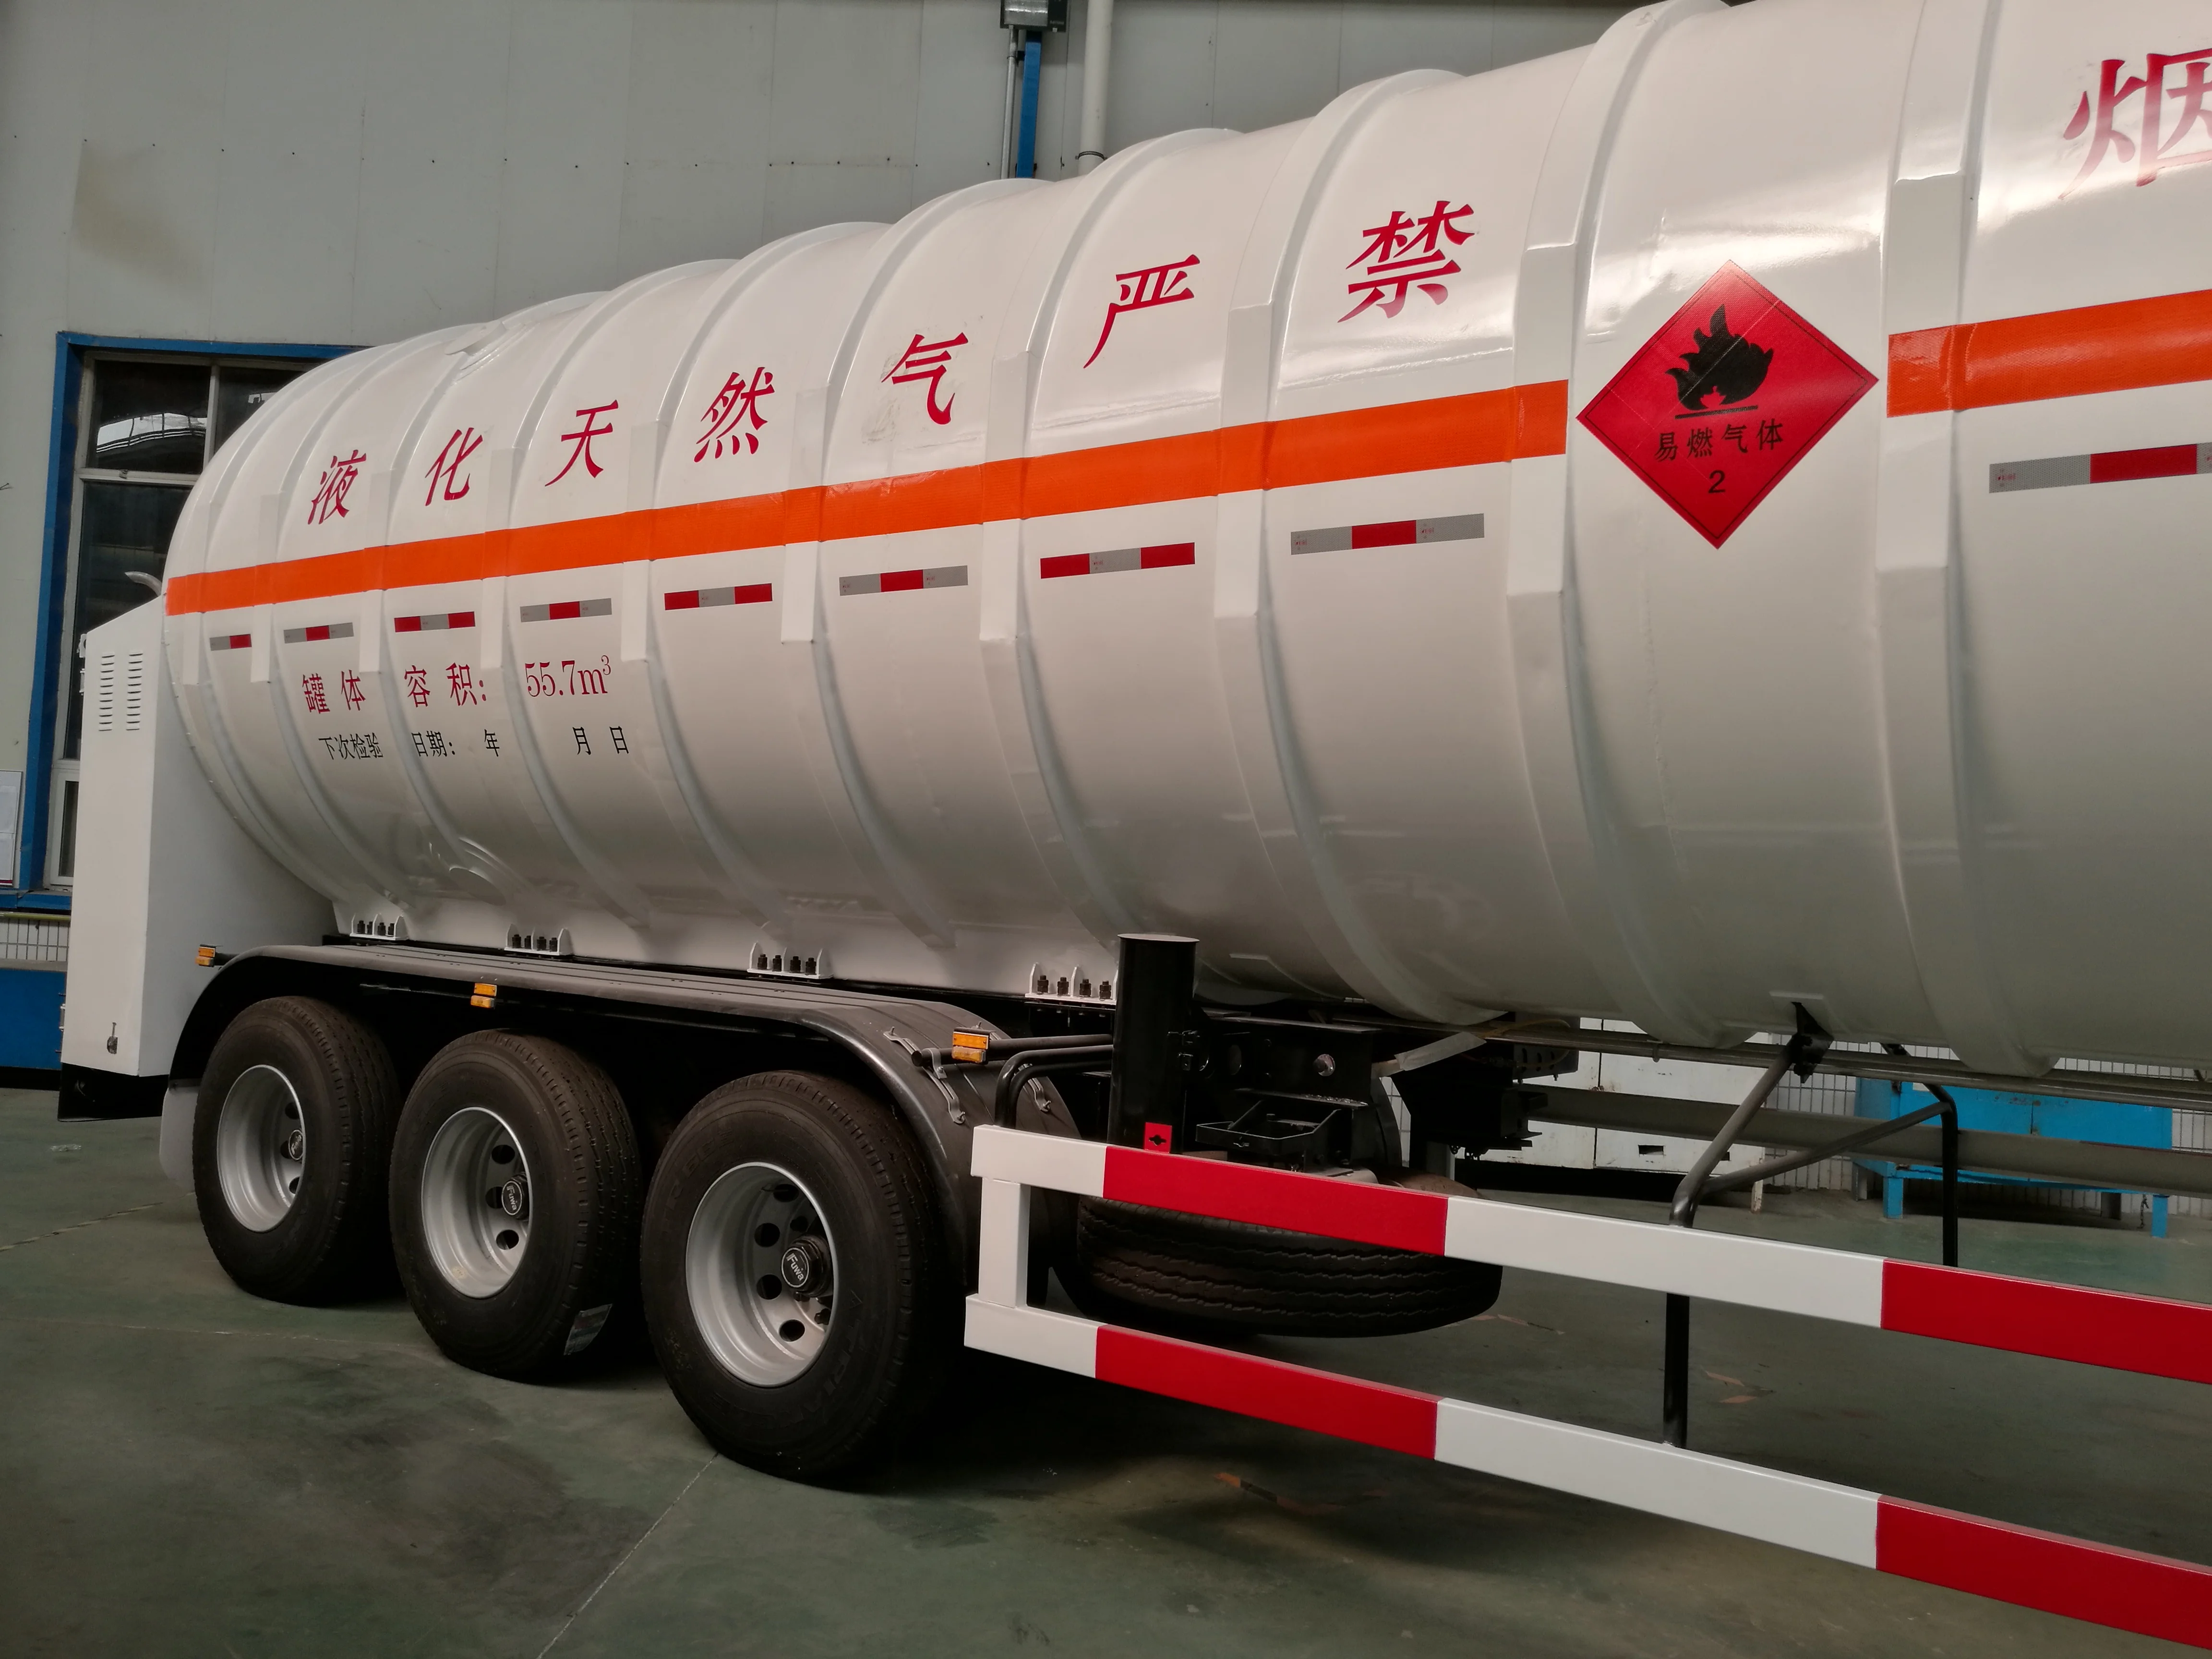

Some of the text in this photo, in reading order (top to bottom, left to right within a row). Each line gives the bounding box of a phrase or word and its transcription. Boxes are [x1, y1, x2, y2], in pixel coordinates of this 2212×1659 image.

[1654, 418, 1784, 462] 易燃气体
[1708, 470, 1726, 493] 2
[318, 731, 384, 760] 下次检验
[483, 728, 500, 757] 年
[573, 726, 592, 756] 月
[610, 725, 629, 755] 日
[785, 1252, 805, 1282] Fuwa
